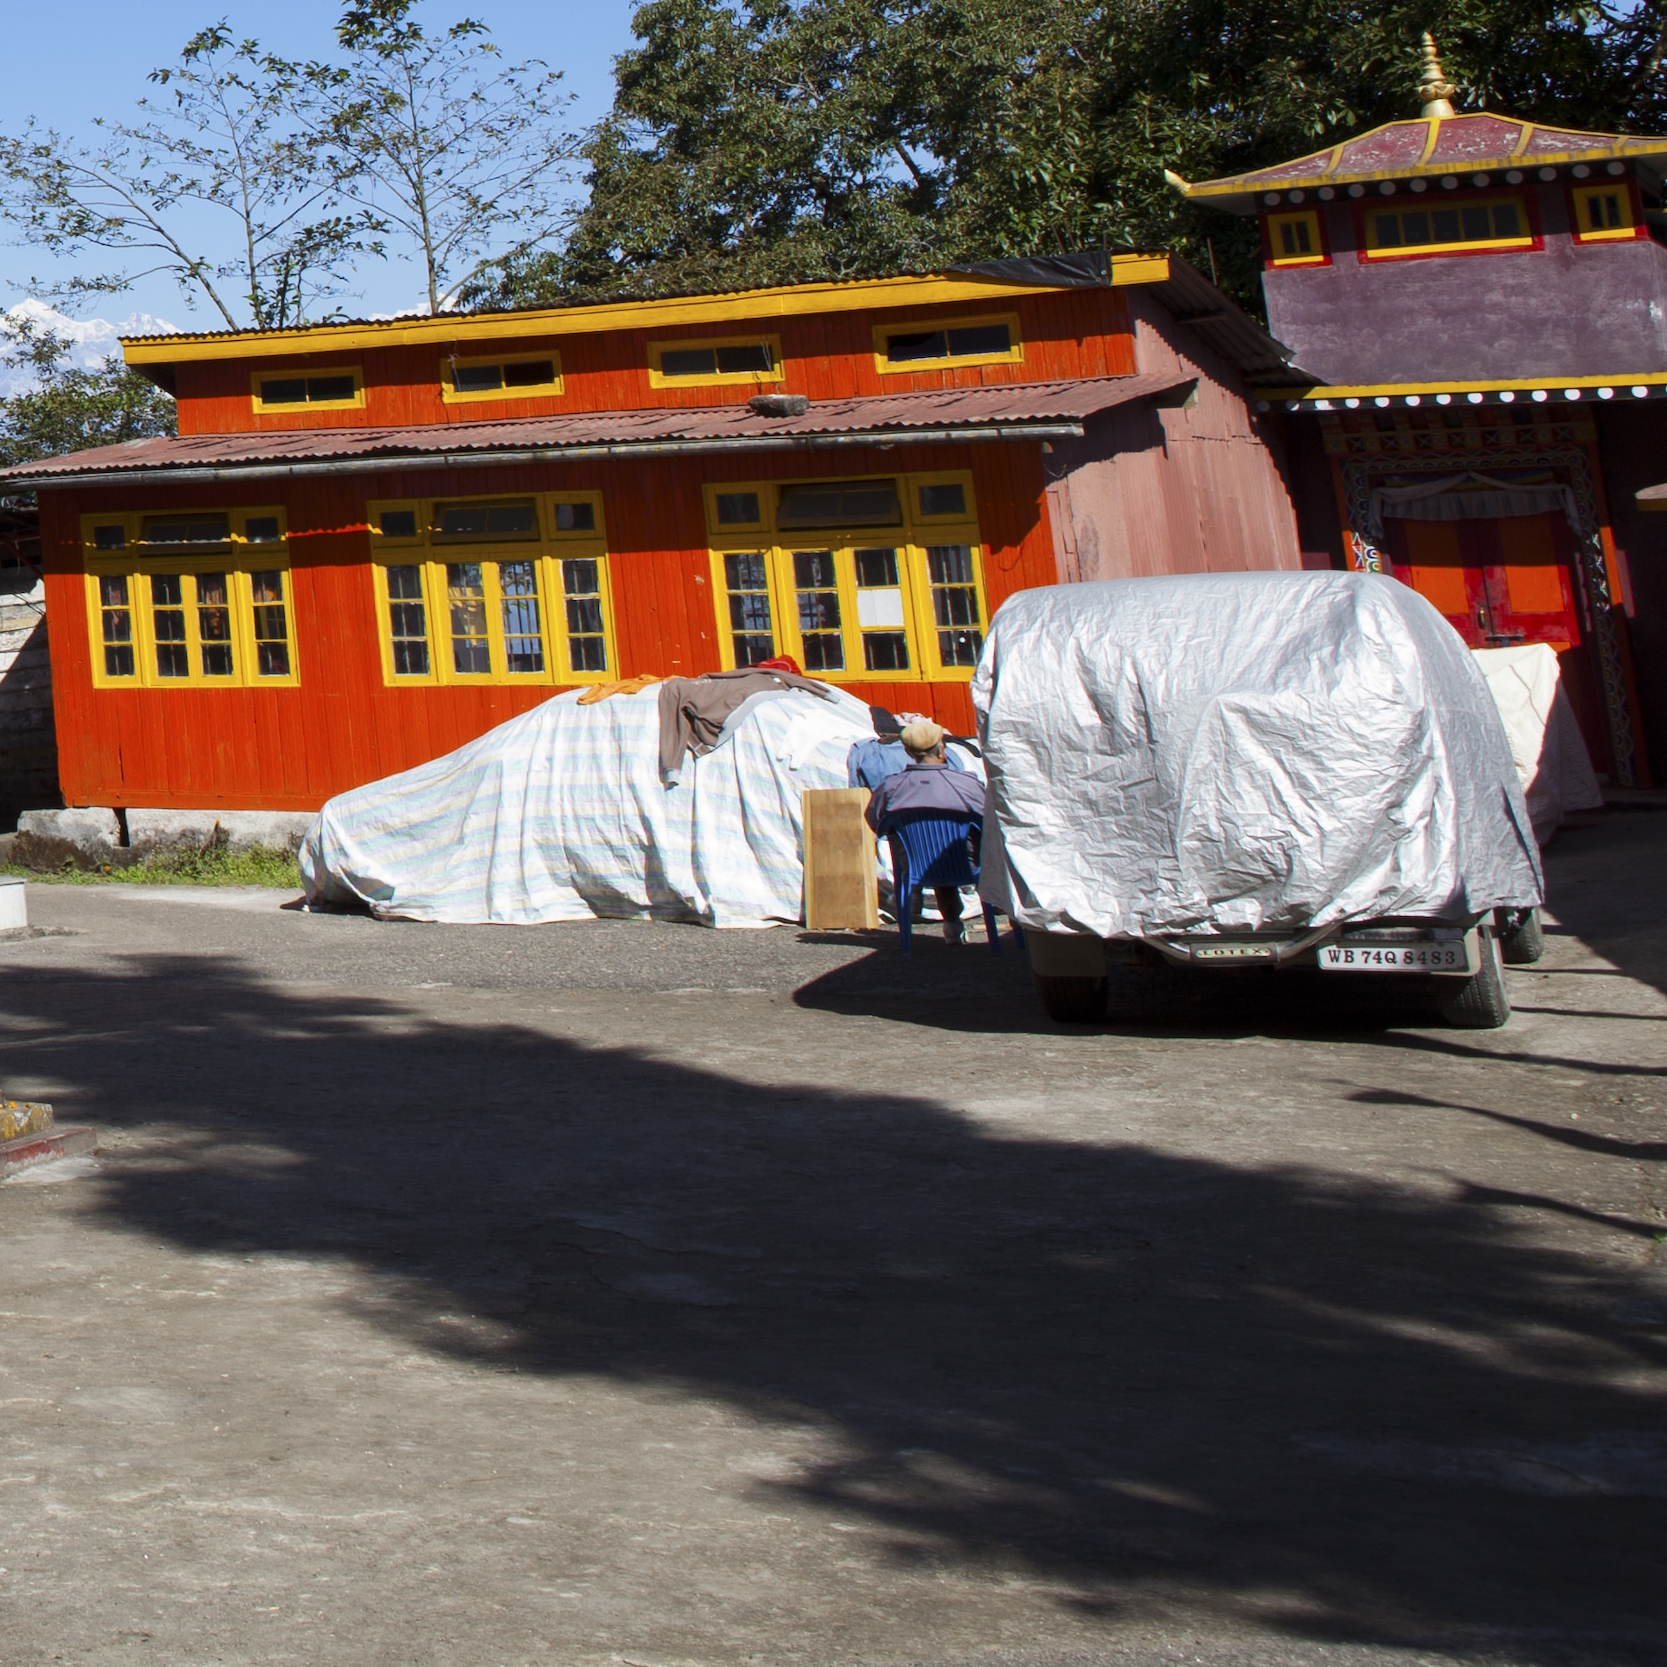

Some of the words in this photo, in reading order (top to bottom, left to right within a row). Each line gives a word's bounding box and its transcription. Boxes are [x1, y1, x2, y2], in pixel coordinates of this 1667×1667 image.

[1328, 950, 1355, 963] WB
[1361, 951, 1398, 964] 74Q
[1403, 951, 1455, 965] 8483
